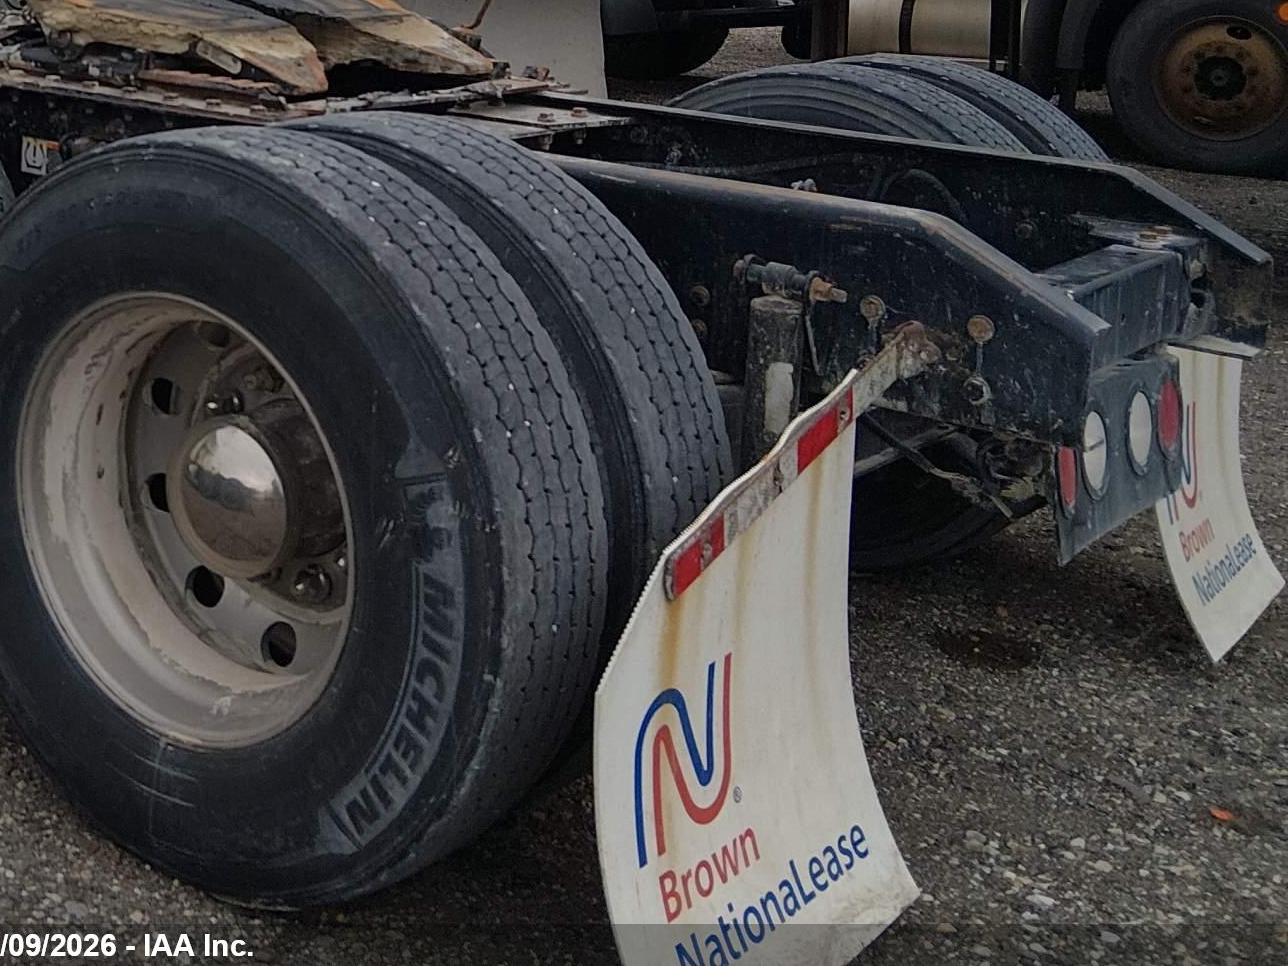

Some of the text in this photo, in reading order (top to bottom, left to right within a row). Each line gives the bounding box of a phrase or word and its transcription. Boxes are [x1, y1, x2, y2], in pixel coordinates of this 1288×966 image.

[1178, 517, 1216, 563] Brown
[1191, 533, 1258, 607] NationaLease
[345, 572, 458, 828] MICHELIN
[658, 827, 761, 923] Brown
[674, 824, 869, 966] NationaLease
